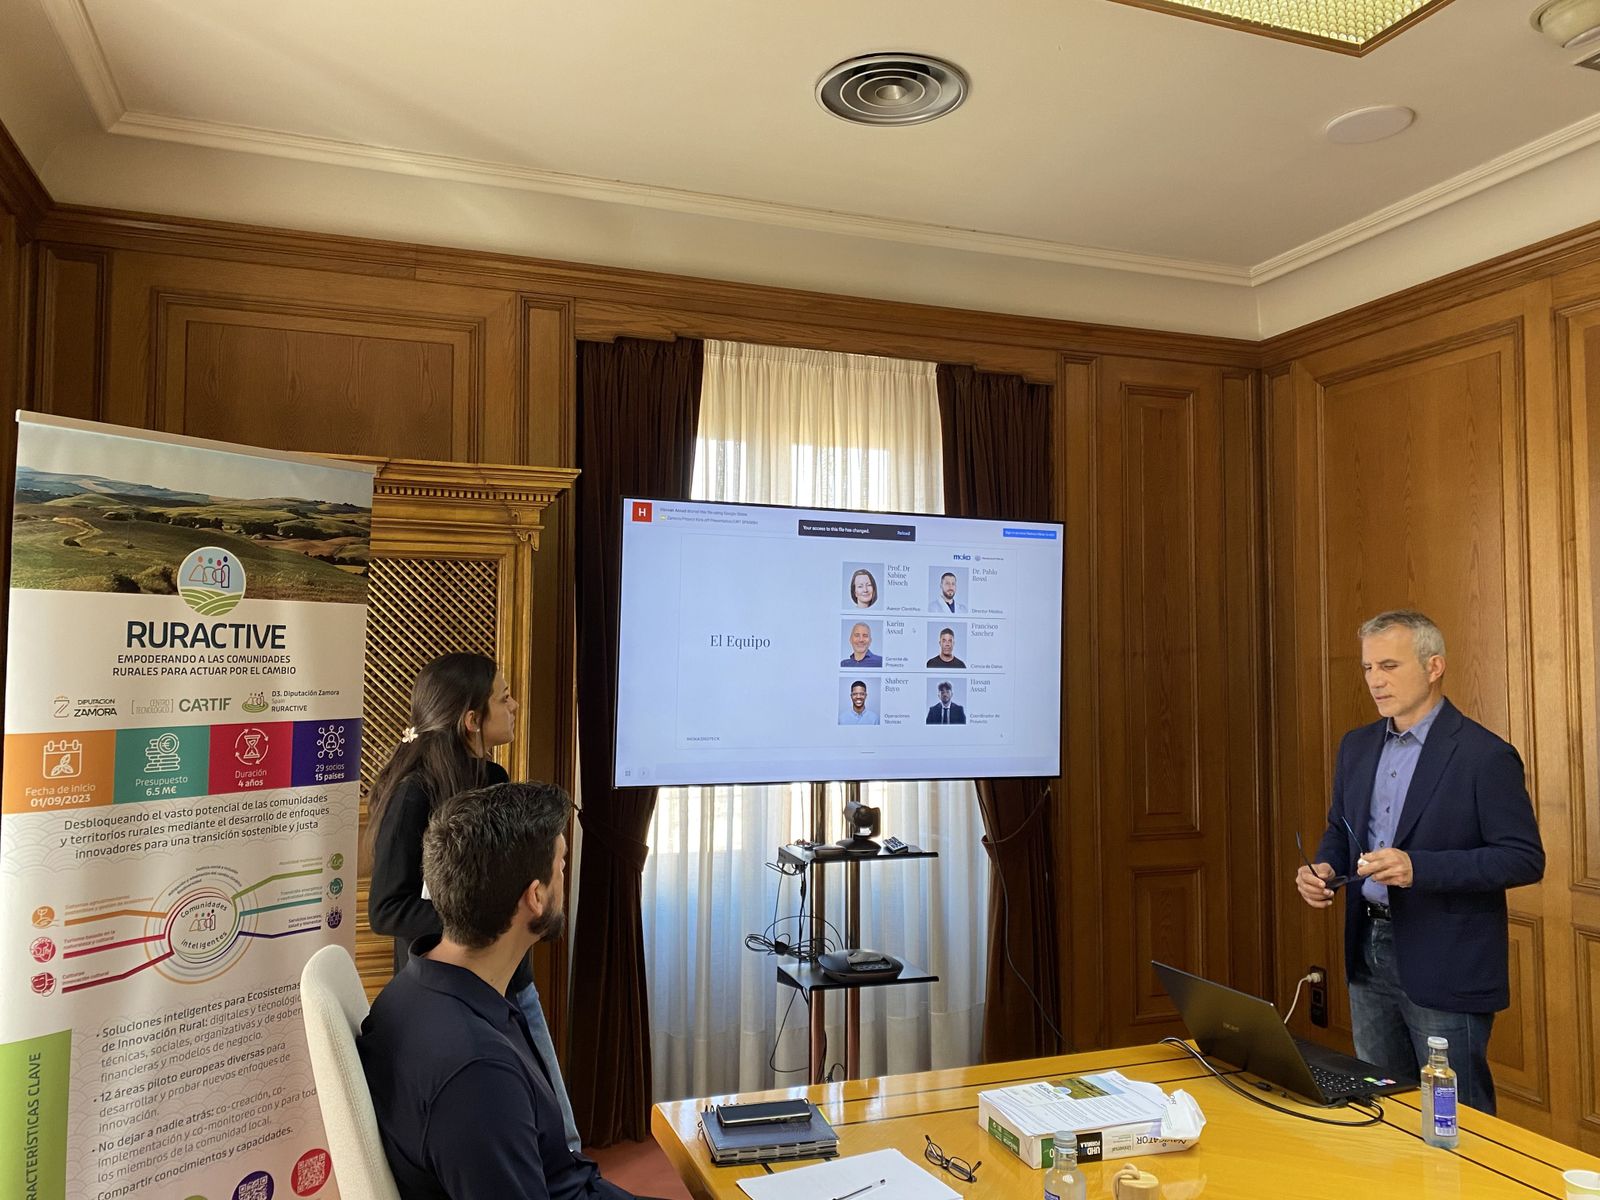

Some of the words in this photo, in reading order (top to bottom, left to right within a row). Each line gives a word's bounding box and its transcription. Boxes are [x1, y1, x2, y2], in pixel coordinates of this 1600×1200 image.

[638, 508, 647, 517] H
[126, 620, 286, 650] RURACTIVE
[710, 634, 722, 647] El
[726, 635, 770, 650] Equipo
[112, 667, 158, 676] RURALES
[160, 667, 188, 676] PARA
[190, 667, 227, 675] ACTUAR
[229, 667, 248, 675] POR
[250, 666, 260, 675] EL
[262, 666, 296, 675] CAMBIO
[118, 654, 196, 664] EMPODERANDO
[198, 654, 205, 664] A
[208, 655, 224, 664] LAS
[226, 655, 291, 664] COMUNIDADES
[74, 708, 117, 718] ZAMORA
[178, 698, 232, 712] CARTIF
[136, 776, 188, 787] Presupuesto
[235, 769, 267, 778] Duración
[238, 780, 244, 788] 4
[245, 779, 264, 787] años
[25, 786, 55, 797] Fecha
[57, 785, 69, 794] de
[30, 794, 91, 808] 01/09/2023
[146, 787, 160, 796] 6.5
[161, 786, 176, 795] M€
[64, 812, 149, 830] Desbloqueando
[152, 810, 161, 820] el
[164, 808, 193, 818] vasto
[195, 802, 240, 817] potencial
[242, 802, 253, 810] de
[255, 800, 268, 809] las
[270, 794, 328, 807] comunidades
[60, 838, 67, 848] y
[70, 830, 126, 844] territorios
[128, 826, 165, 836] rurales
[168, 820, 216, 833] mediante
[218, 818, 226, 826] el
[228, 812, 274, 826] desarrollo
[276, 811, 288, 819] de
[289, 807, 330, 818] enfoques
[75, 843, 142, 859] innovadores
[144, 841, 168, 851] para
[170, 837, 190, 846] una
[192, 830, 239, 844] transición
[241, 823, 287, 837] sostenible
[288, 824, 294, 833] y
[296, 821, 318, 832] justa
[180, 901, 227, 918] Comunidades
[181, 931, 227, 950] inteligentes
[102, 1017, 161, 1038] Soluciones
[164, 1002, 222, 1023] inteligentes
[224, 996, 245, 1009] para
[248, 982, 301, 1002] Ecosistemas
[101, 1050, 148, 1068] técnicas,
[151, 1038, 192, 1056] sociales,
[194, 1020, 255, 1043] organizativas
[256, 1019, 262, 1028] y
[264, 1014, 275, 1024] de
[102, 1043, 115, 1053] de
[118, 1027, 176, 1049] Innovación
[179, 1019, 208, 1033] Rural:
[210, 1008, 249, 1025] digitales
[250, 1007, 256, 1016] y
[101, 1061, 158, 1082] financieras
[160, 1059, 167, 1070] y
[169, 1048, 210, 1064] modelos
[212, 1042, 224, 1052] de
[226, 1032, 263, 1048] negocio.
[28, 1052, 41, 1096] CLAVE
[100, 1092, 112, 1102] 12
[114, 1084, 145, 1099] áreas
[147, 1074, 178, 1090] piloto
[180, 1060, 224, 1079] europeas
[227, 1048, 265, 1065] diversas
[266, 1042, 286, 1054] para
[100, 1094, 158, 1117] desarrollar
[160, 1092, 166, 1103] y
[168, 1082, 200, 1099] probar
[202, 1070, 236, 1086] nuevos
[238, 1057, 278, 1076] enfoques
[280, 1053, 290, 1062] de
[98, 1133, 182, 1168] implementación
[184, 1130, 190, 1139] y
[192, 1110, 256, 1136] co-monitoreo
[257, 1103, 272, 1114] con
[274, 1101, 280, 1110] y
[282, 1095, 300, 1108] para
[99, 1142, 114, 1152] No
[117, 1131, 145, 1147] dejar
[147, 1130, 153, 1138] a
[156, 1119, 184, 1134] nadie
[186, 1109, 214, 1125] atrás:
[216, 1091, 271, 1114] co-creación,
[272, 1086, 286, 1096] co-
[99, 1108, 159, 1133] innovación.
[97, 1176, 153, 1200] Compartir
[154, 1149, 227, 1182] conocimientos
[228, 1148, 235, 1157] y
[236, 1126, 293, 1152] capacidades.
[98, 1171, 114, 1183] los
[116, 1153, 168, 1176] miembros
[170, 1148, 182, 1158] de
[184, 1144, 193, 1153] la
[195, 1124, 247, 1148] comunidad
[248, 1116, 272, 1130] local.
